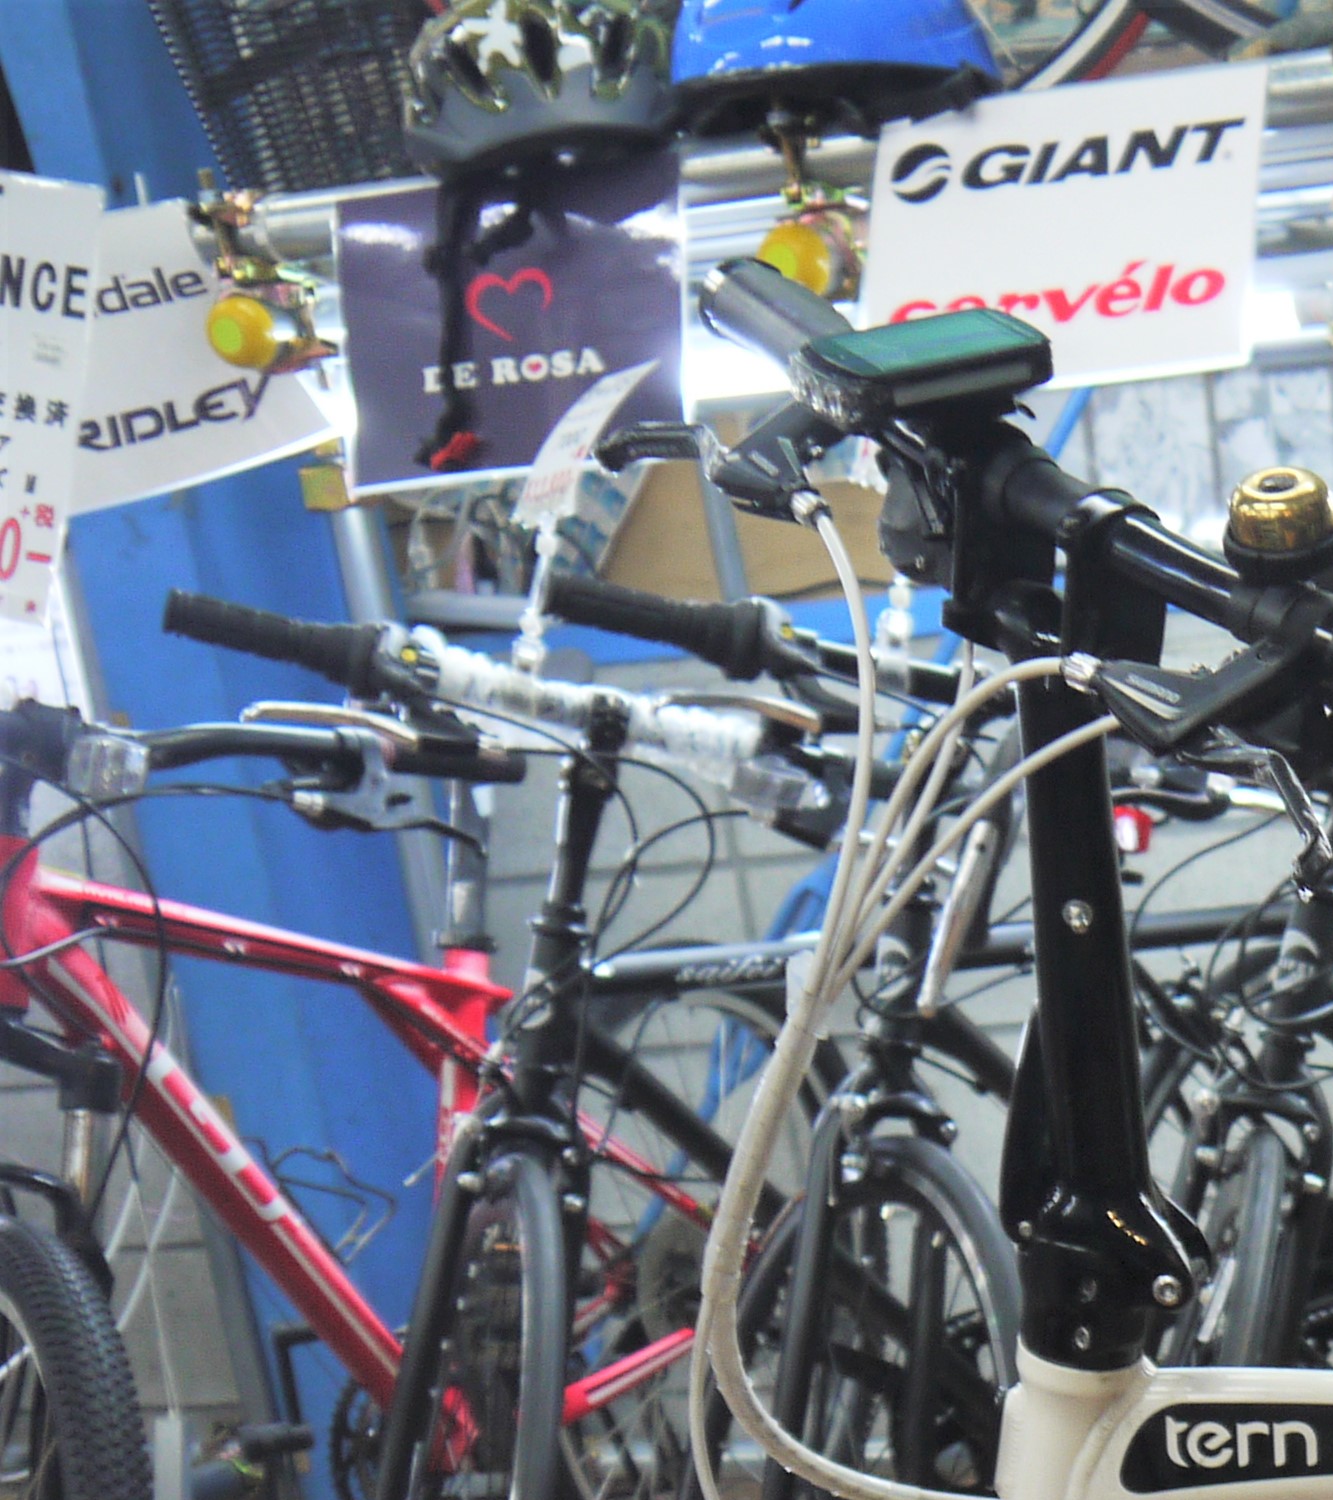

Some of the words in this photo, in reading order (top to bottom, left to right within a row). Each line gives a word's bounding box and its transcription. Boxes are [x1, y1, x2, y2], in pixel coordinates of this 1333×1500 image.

[961, 117, 1246, 190] GIANT
[492, 347, 606, 386] ROSA
[77, 374, 271, 452] RIDLEY
[1165, 1414, 1319, 1469] tern
